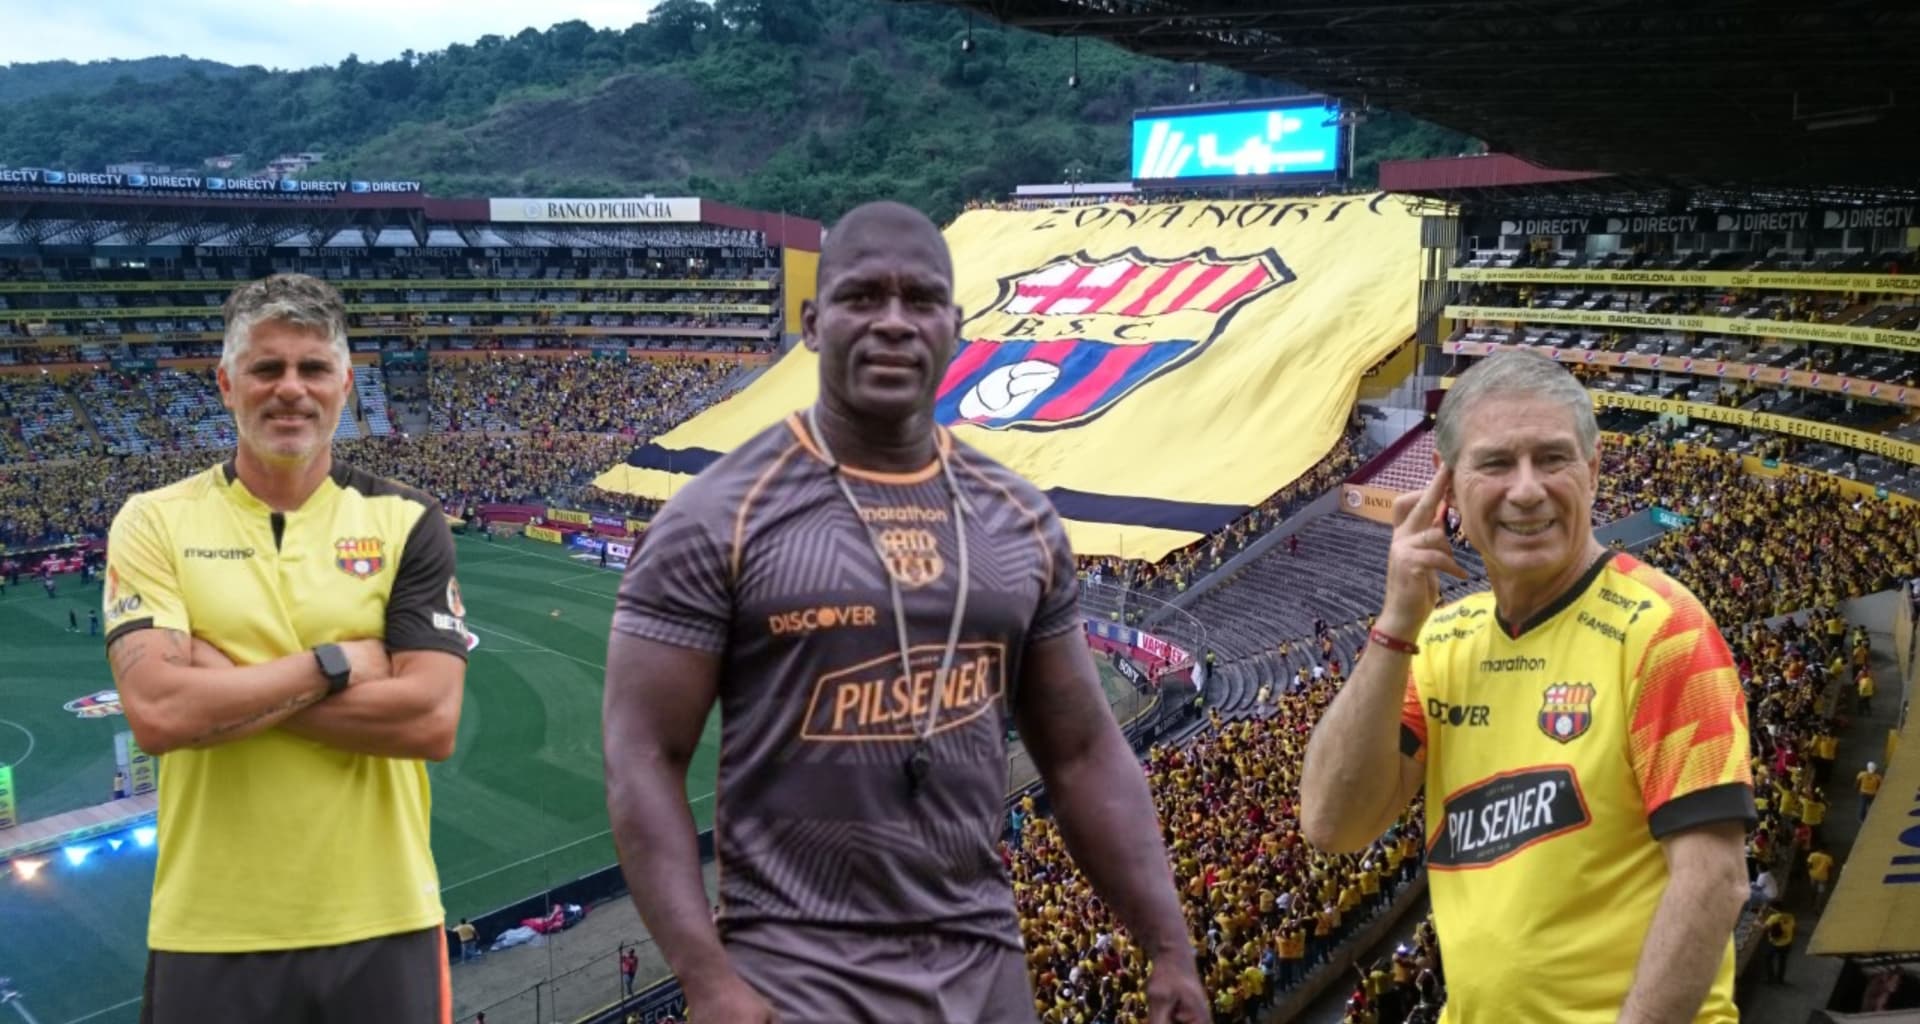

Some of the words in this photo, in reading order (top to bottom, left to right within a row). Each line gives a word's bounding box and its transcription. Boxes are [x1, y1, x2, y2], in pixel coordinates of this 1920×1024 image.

[67, 173, 122, 185] DIRECTV
[150, 177, 201, 188] DIRECTV
[227, 179, 276, 190] DIRECTV
[300, 181, 347, 191] DIRECTV
[372, 181, 421, 192] DIRECTV
[547, 202, 596, 219] BANCO
[599, 201, 673, 219] PICHINCHA
[1032, 205, 1185, 231] ZONA
[1850, 208, 1914, 227] DIRECTV
[1526, 219, 1589, 234] DIRECTV
[1633, 216, 1698, 233] DIRECTV
[1744, 212, 1808, 231] DIRECTV
[1611, 273, 1675, 283] BARCELONA
[1608, 314, 1672, 326] BARCELONA
[1598, 395, 1669, 413] SERVICIO
[1676, 404, 1694, 415] DE
[1702, 407, 1745, 424] TAXIS
[1788, 421, 1858, 446] EFICIENTE
[1864, 438, 1914, 460] SEGURO
[861, 505, 948, 521] marathon
[769, 605, 877, 636] DISCOVER
[1480, 656, 1546, 672] marathon
[832, 656, 990, 731] PILSENER
[1448, 780, 1558, 860] PILSENER
